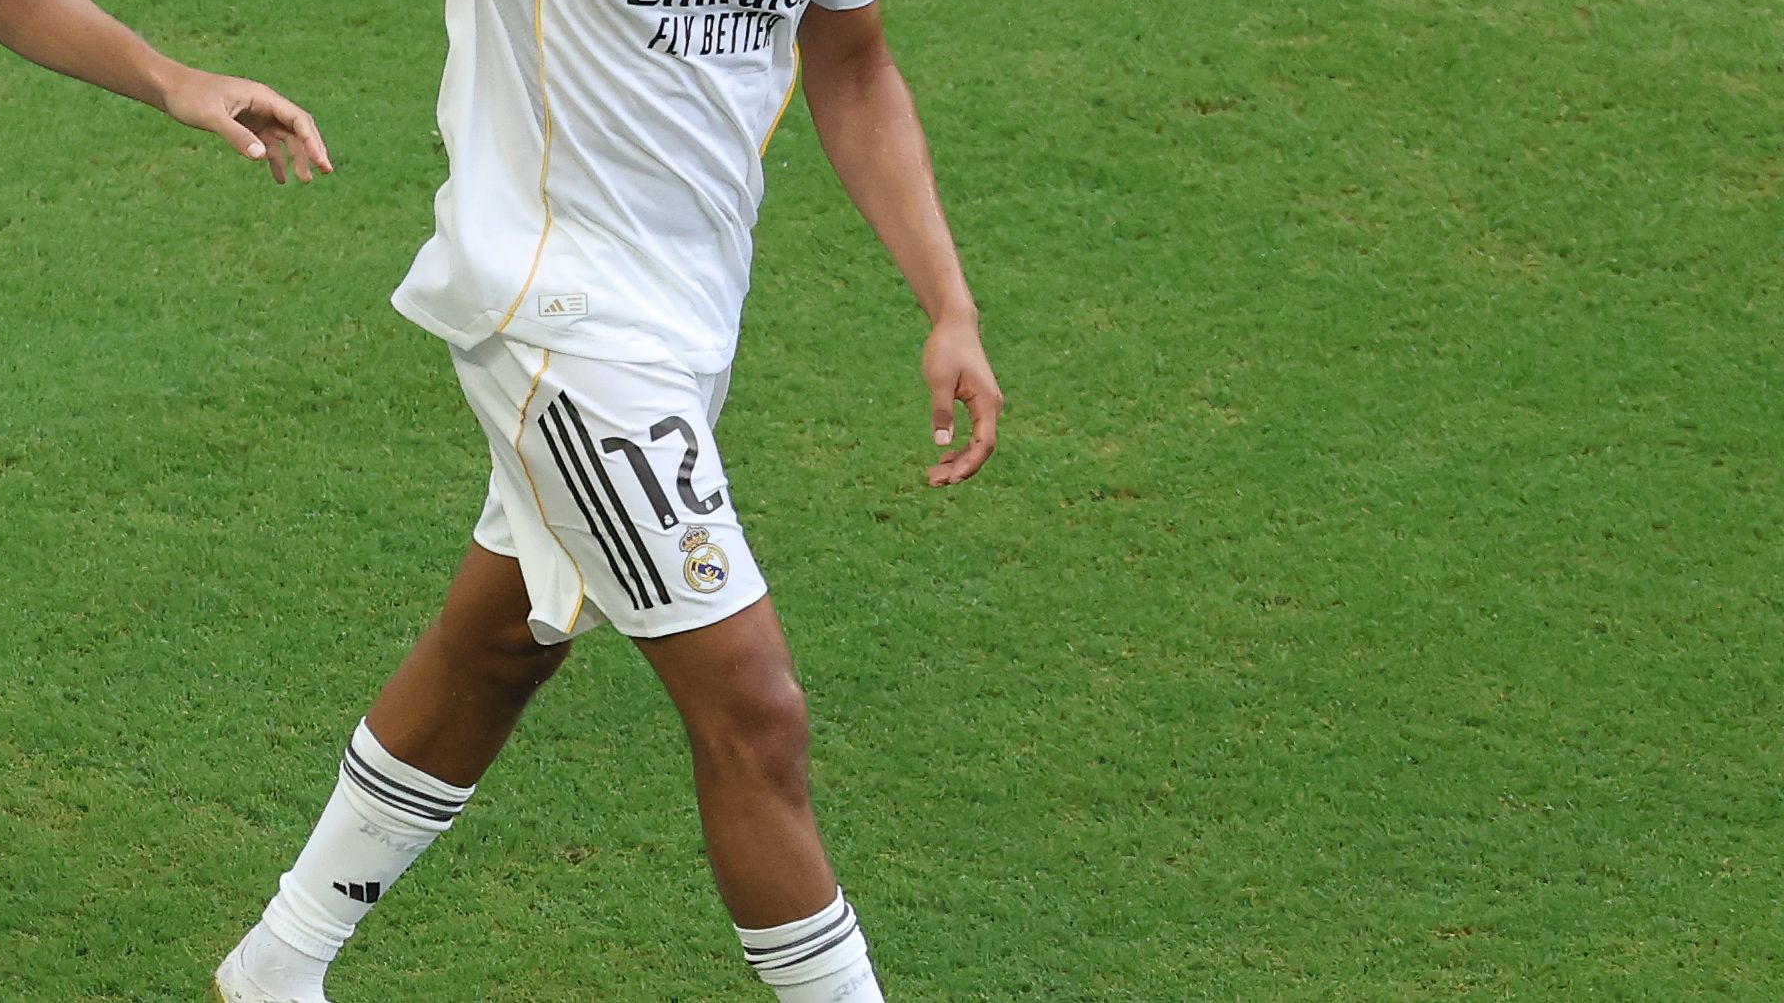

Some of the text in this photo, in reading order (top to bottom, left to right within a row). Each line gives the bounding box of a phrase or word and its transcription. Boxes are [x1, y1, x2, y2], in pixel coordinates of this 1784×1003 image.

[647, 10, 786, 58] FLY BETTER
[599, 415, 725, 531] 12
